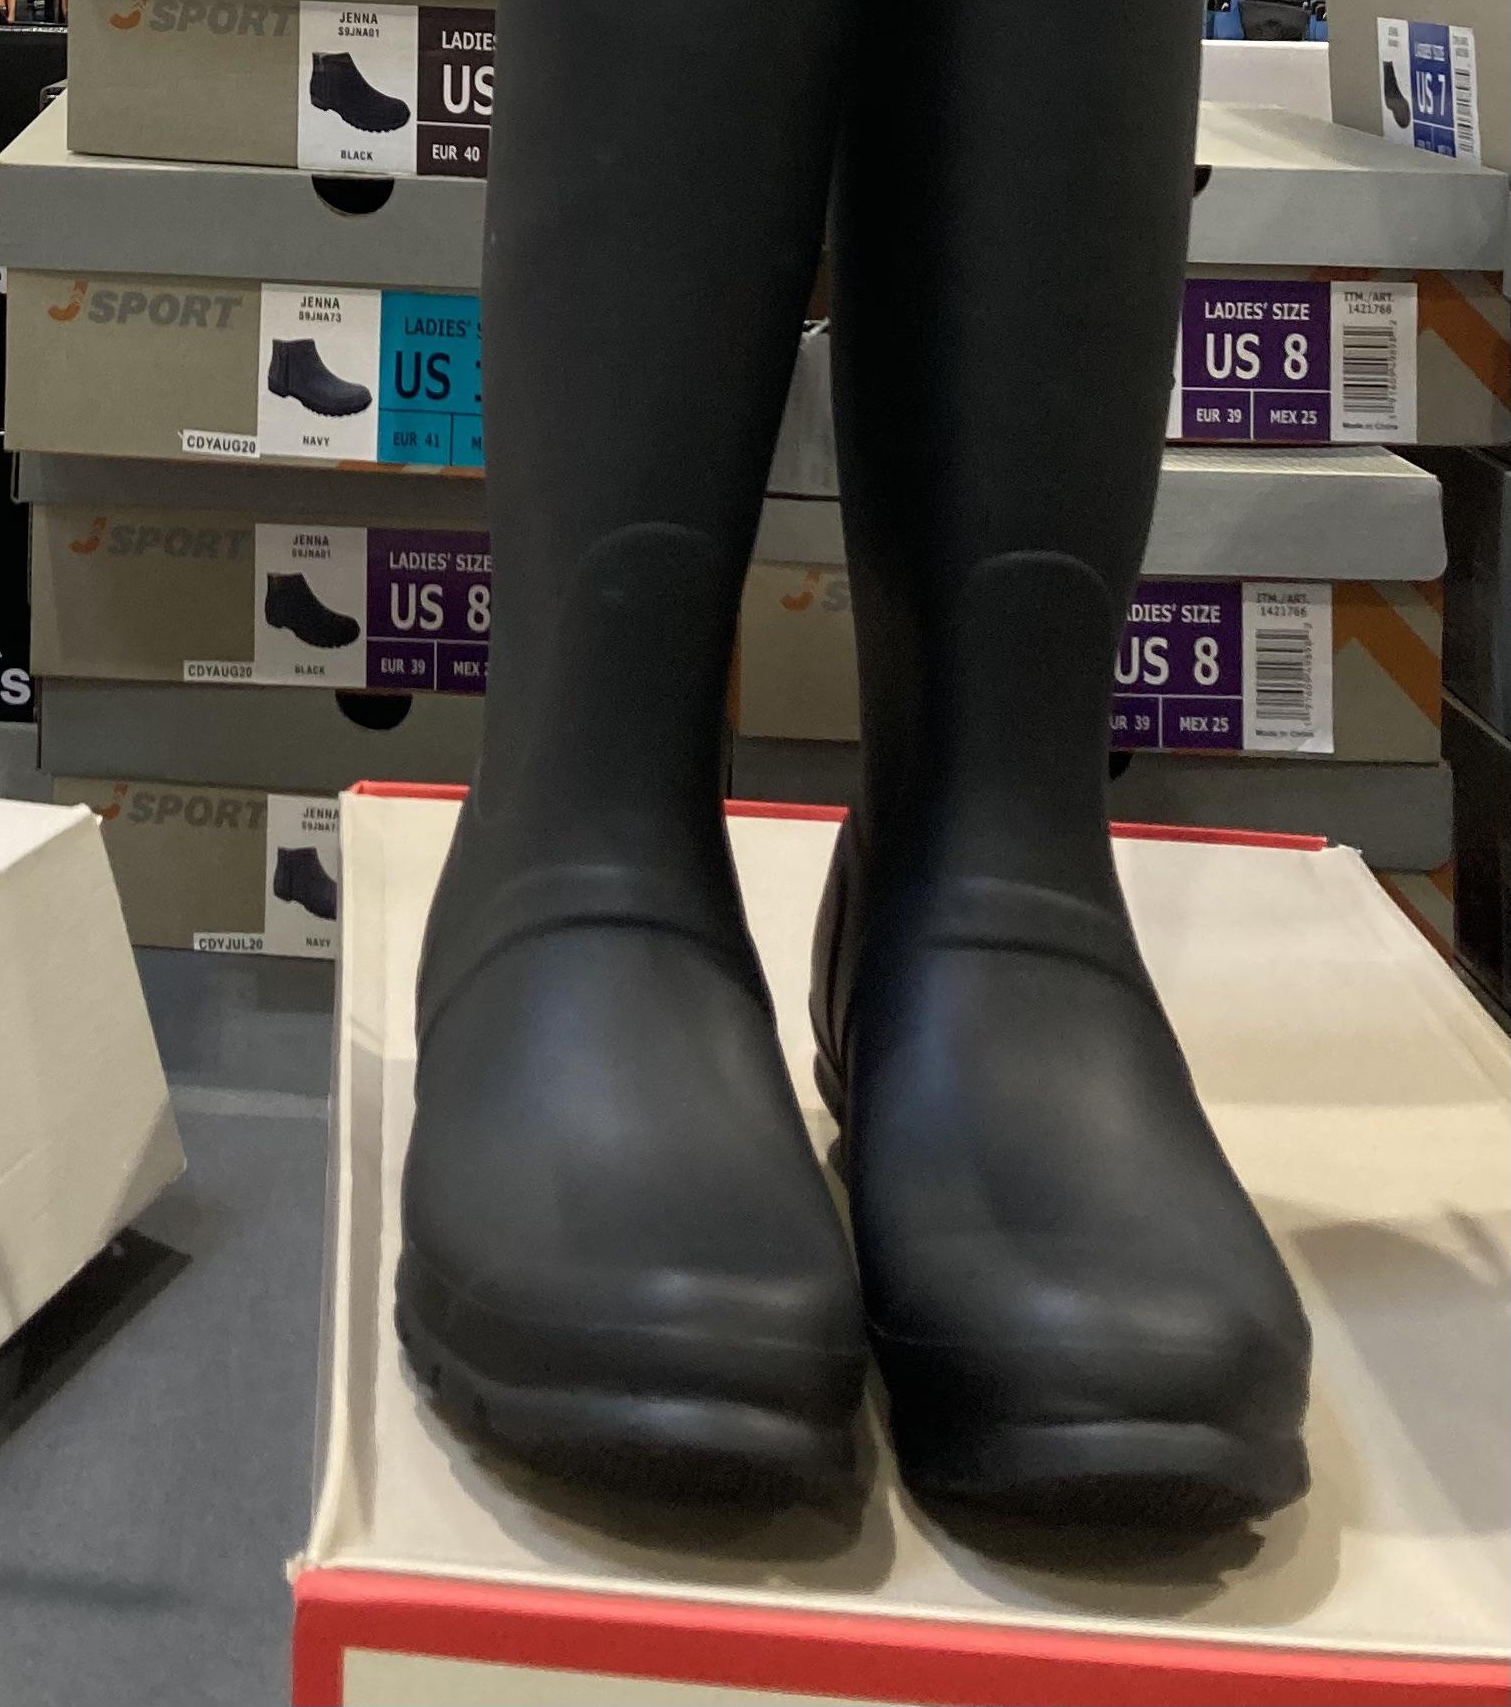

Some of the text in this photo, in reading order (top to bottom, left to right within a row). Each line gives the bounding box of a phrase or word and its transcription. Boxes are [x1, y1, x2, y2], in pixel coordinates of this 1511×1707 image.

[339, 11, 378, 25] JENNA
[442, 64, 495, 116] US
[1416, 71, 1446, 116] US 7
[340, 149, 374, 161] BLACK
[431, 144, 480, 162] EUR 40
[301, 295, 340, 310] JENNA
[1205, 301, 1310, 321] LADIES' SIZE
[404, 316, 470, 338] LADIES'
[1206, 332, 1308, 380] US 8
[394, 350, 451, 400] US
[1196, 408, 1242, 424] EUR 39
[1270, 410, 1318, 425] MEX 25
[186, 434, 256, 454] CDYAUG20
[302, 434, 330, 447] NAVY
[393, 431, 440, 449] EUR 41
[291, 534, 330, 548] JENNA
[389, 551, 492, 574] LADIES' SIZE
[391, 583, 491, 632] US 8
[1181, 605, 1221, 623] SIZE
[381, 658, 426, 675] EUR 39
[453, 661, 480, 677] MEX
[1114, 637, 1219, 685] US 8
[294, 664, 326, 676] BLACK
[1135, 715, 1150, 730] 39
[1180, 717, 1229, 732] MEX 25
[303, 807, 339, 821] JENNA
[199, 937, 263, 951] CDYJUL20
